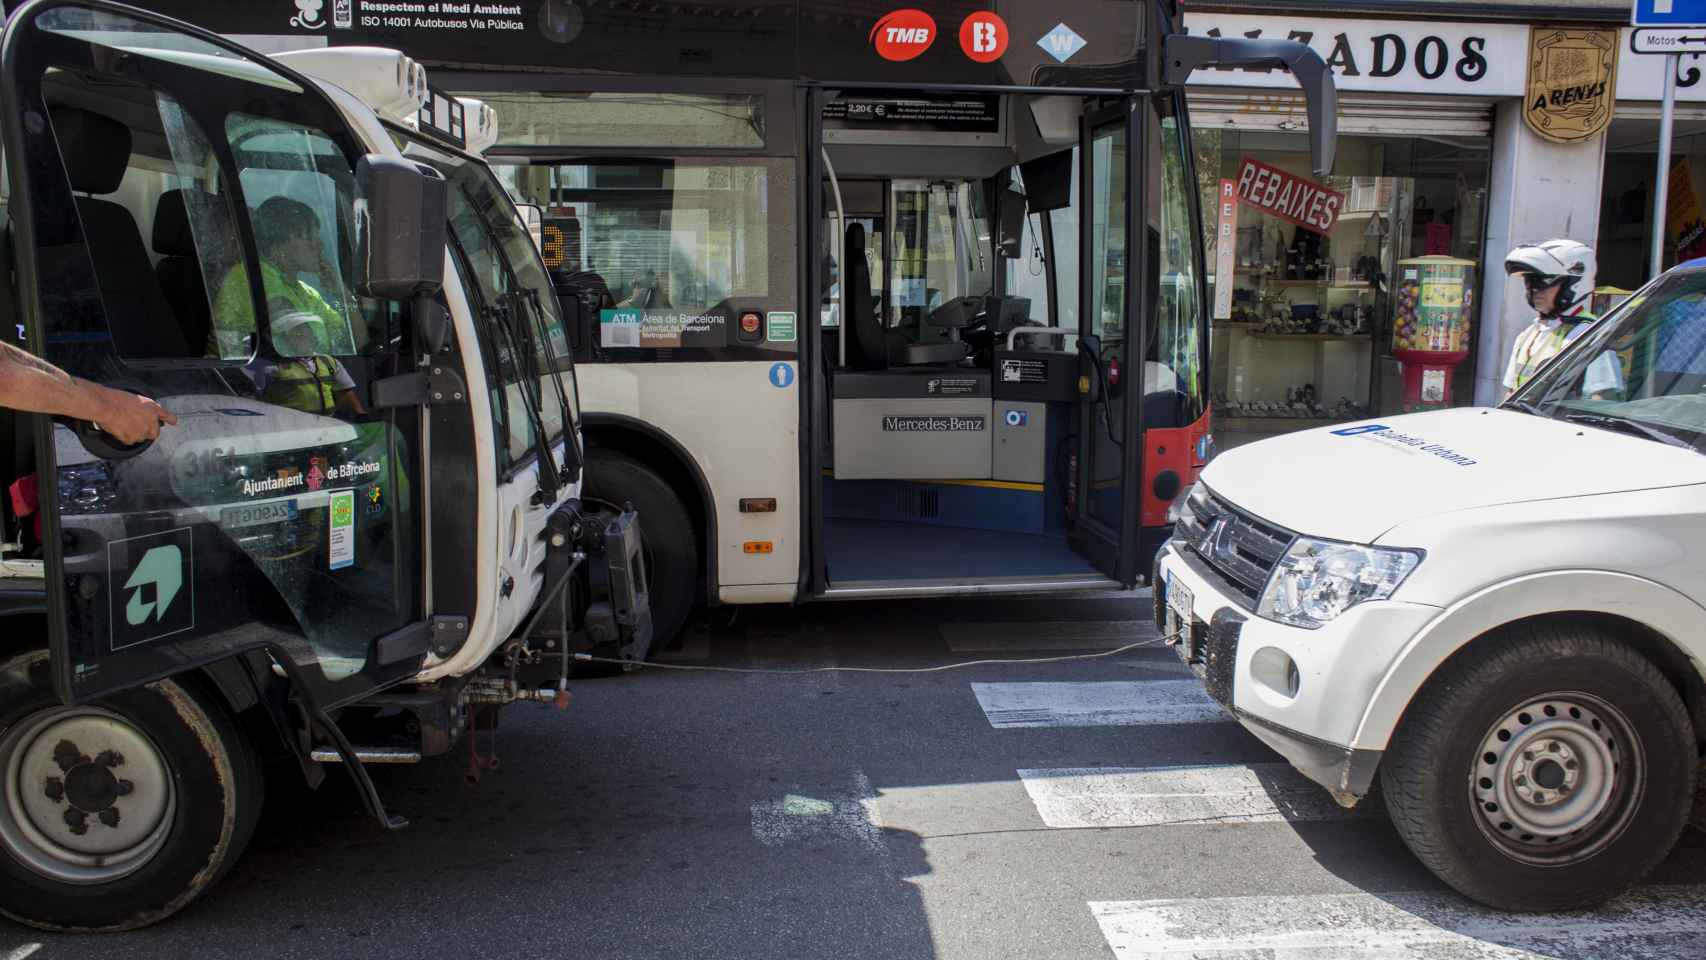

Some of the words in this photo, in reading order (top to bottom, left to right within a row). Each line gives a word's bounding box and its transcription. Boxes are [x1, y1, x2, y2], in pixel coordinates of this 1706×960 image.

[361, 2, 425, 13] Respectem
[428, 3, 440, 13] el
[442, 3, 470, 14] Medi
[473, 4, 521, 15] Ambient
[361, 18, 380, 27] ISO
[383, 18, 412, 27] 14001
[414, 19, 468, 29] Autobusos
[487, 19, 524, 30] Pública
[886, 28, 929, 43] TMB
[973, 22, 997, 52] B
[1647, 35, 1676, 45] Motos
[1531, 80, 1607, 111] ARENYS
[1236, 162, 1339, 231] REBAIXES
[612, 313, 636, 323] ATM
[665, 313, 678, 323] de
[679, 313, 725, 324] Barcelona
[886, 417, 983, 432] Mercedes-Benz
[327, 465, 338, 480] de
[339, 460, 381, 479] Barcelona
